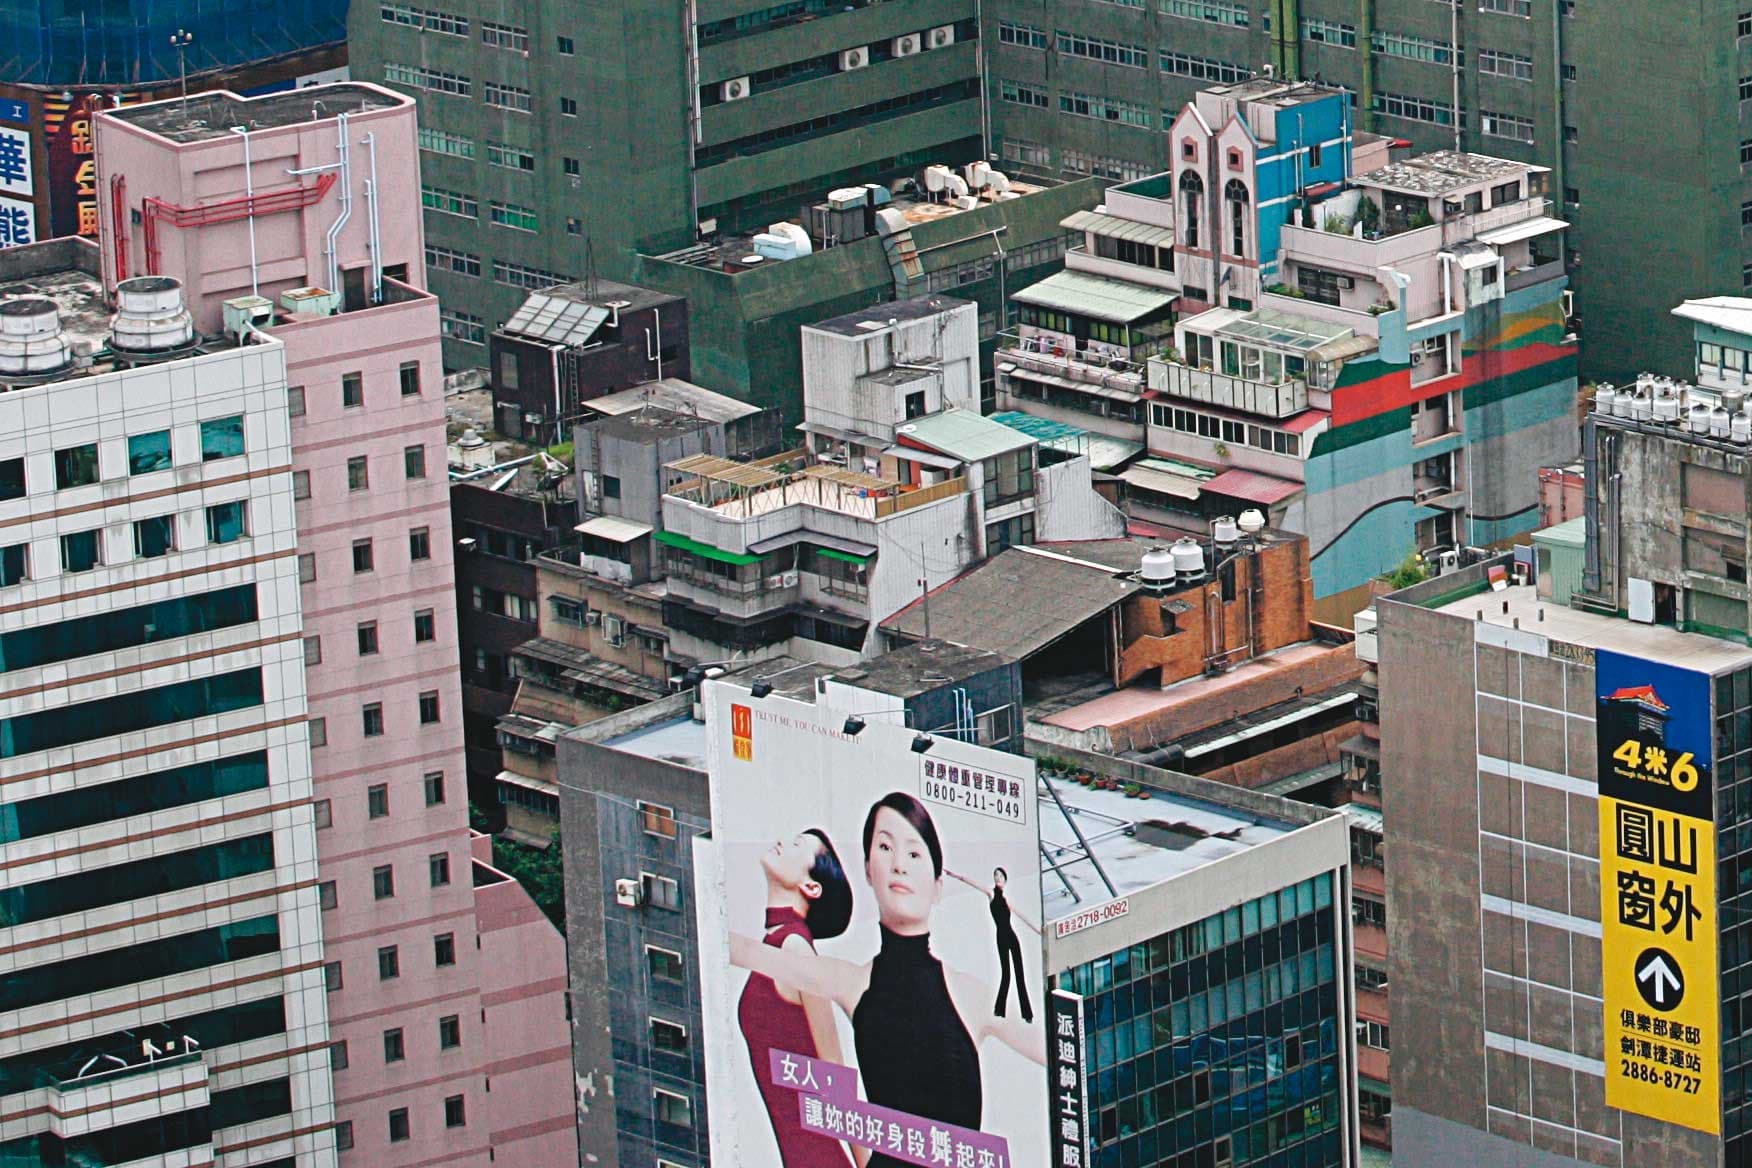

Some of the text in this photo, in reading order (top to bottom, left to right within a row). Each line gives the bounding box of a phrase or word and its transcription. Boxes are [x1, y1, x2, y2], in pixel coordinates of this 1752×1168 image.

[794, 720, 810, 730] YOU
[811, 724, 828, 735] CAN
[926, 781, 1020, 818] 0800-211-049
[1616, 802, 1697, 875] 圓山
[1618, 870, 1702, 942] 窗外
[1621, 1058, 1702, 1096] 2886-8727
